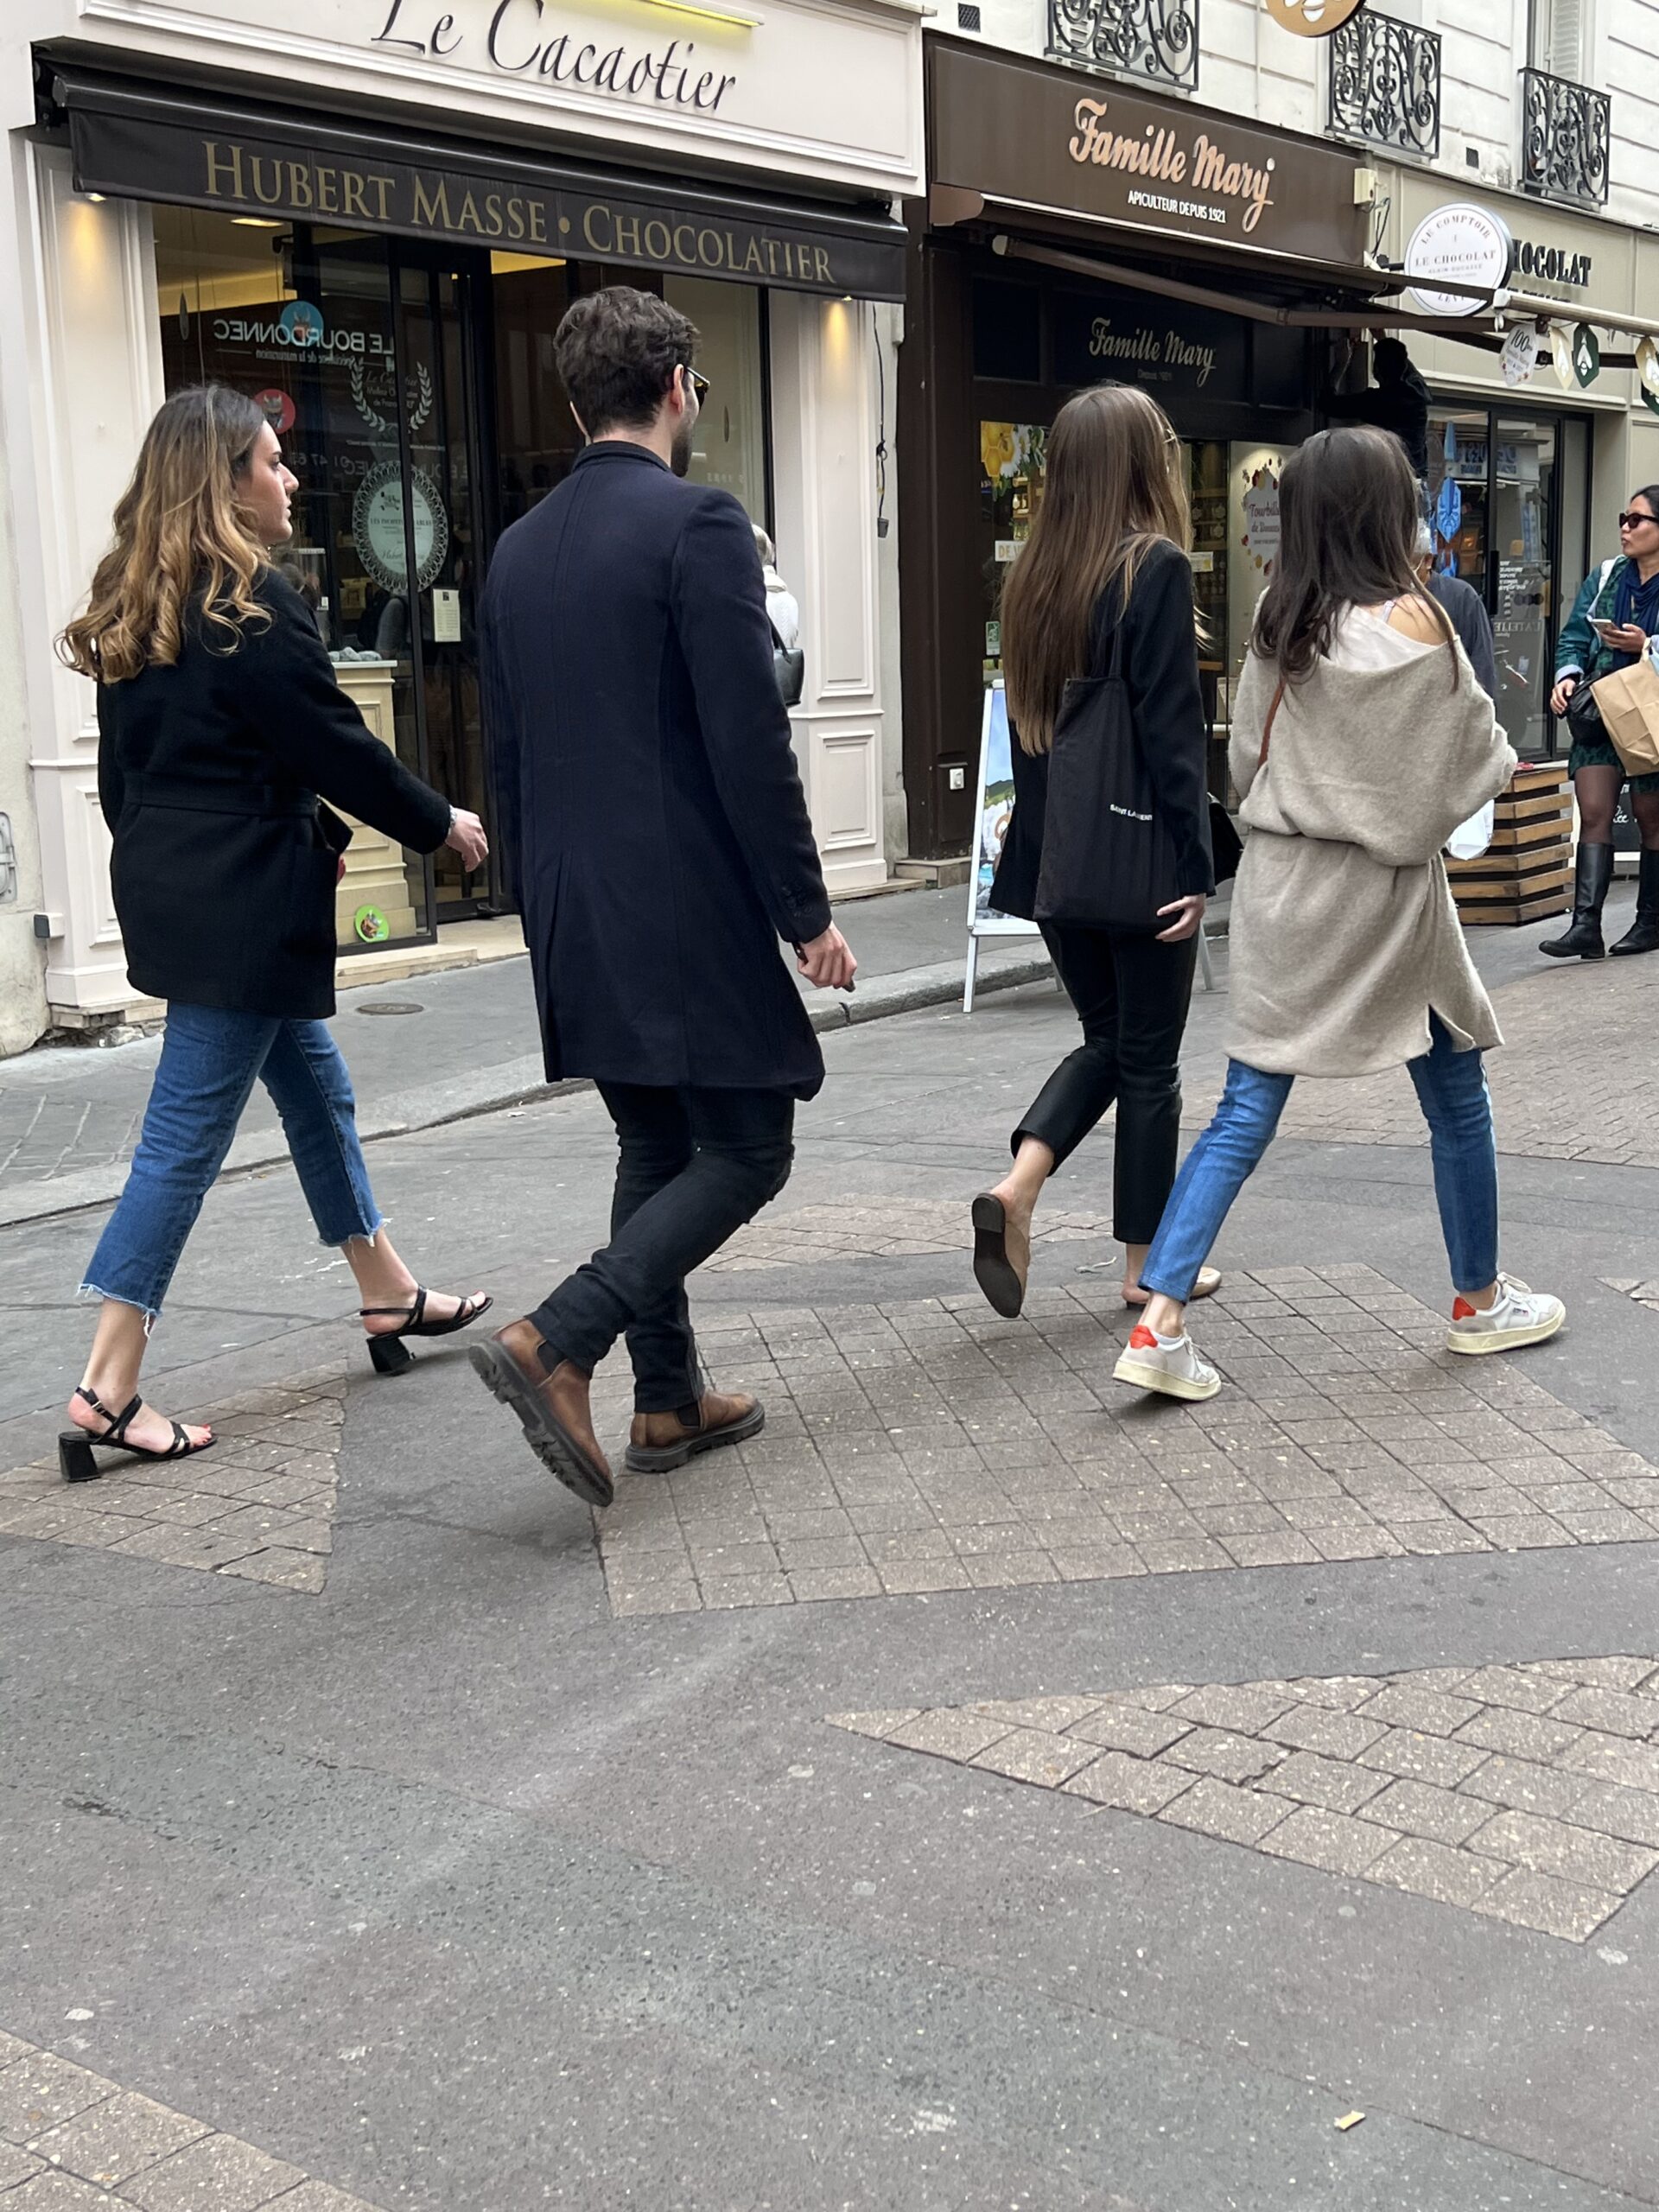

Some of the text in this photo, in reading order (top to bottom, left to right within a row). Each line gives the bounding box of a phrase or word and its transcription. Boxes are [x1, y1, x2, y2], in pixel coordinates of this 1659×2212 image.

[371, 0, 735, 111] Le Cacaotier
[1069, 98, 1275, 233] Famille Mary
[201, 141, 836, 284] HUBERT MASSE CHOCOLATIER
[1128, 189, 1226, 224] APICULTEUR DEPUIS 1921
[1434, 250, 1496, 265] CHOCOLAT
[1511, 238, 1592, 288] HOCOLAT
[1089, 316, 1217, 387] Famille Mary
